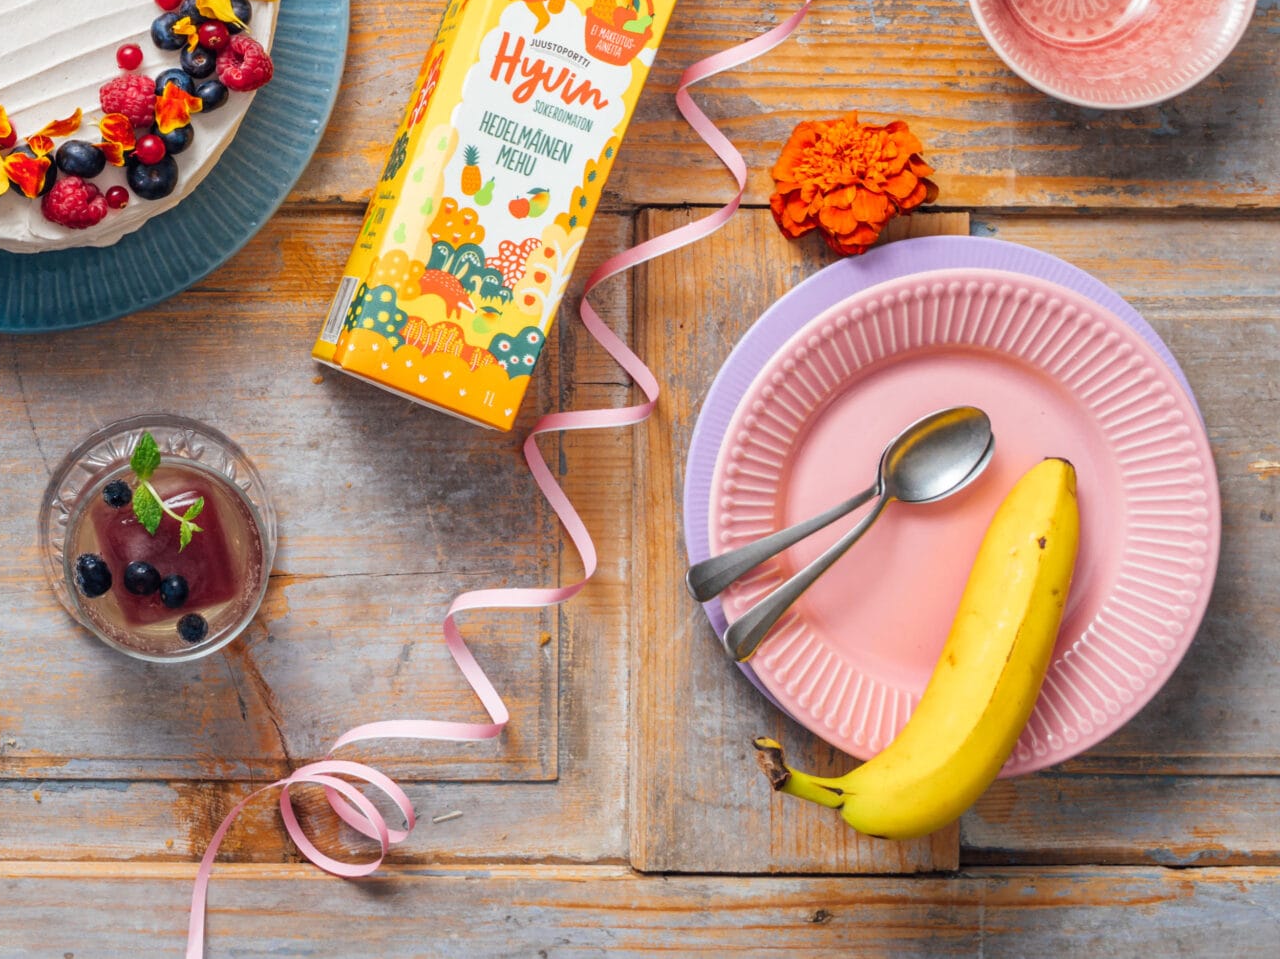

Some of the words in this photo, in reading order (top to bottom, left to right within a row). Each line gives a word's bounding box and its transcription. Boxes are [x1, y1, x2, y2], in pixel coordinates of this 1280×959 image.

[530, 38, 591, 68] JUUSTOPORTTI
[490, 31, 608, 110] Hyvin
[533, 100, 594, 133] SOKEROIMATON
[479, 110, 573, 165] HEDELMÄINEN
[495, 144, 538, 177] MEHU
